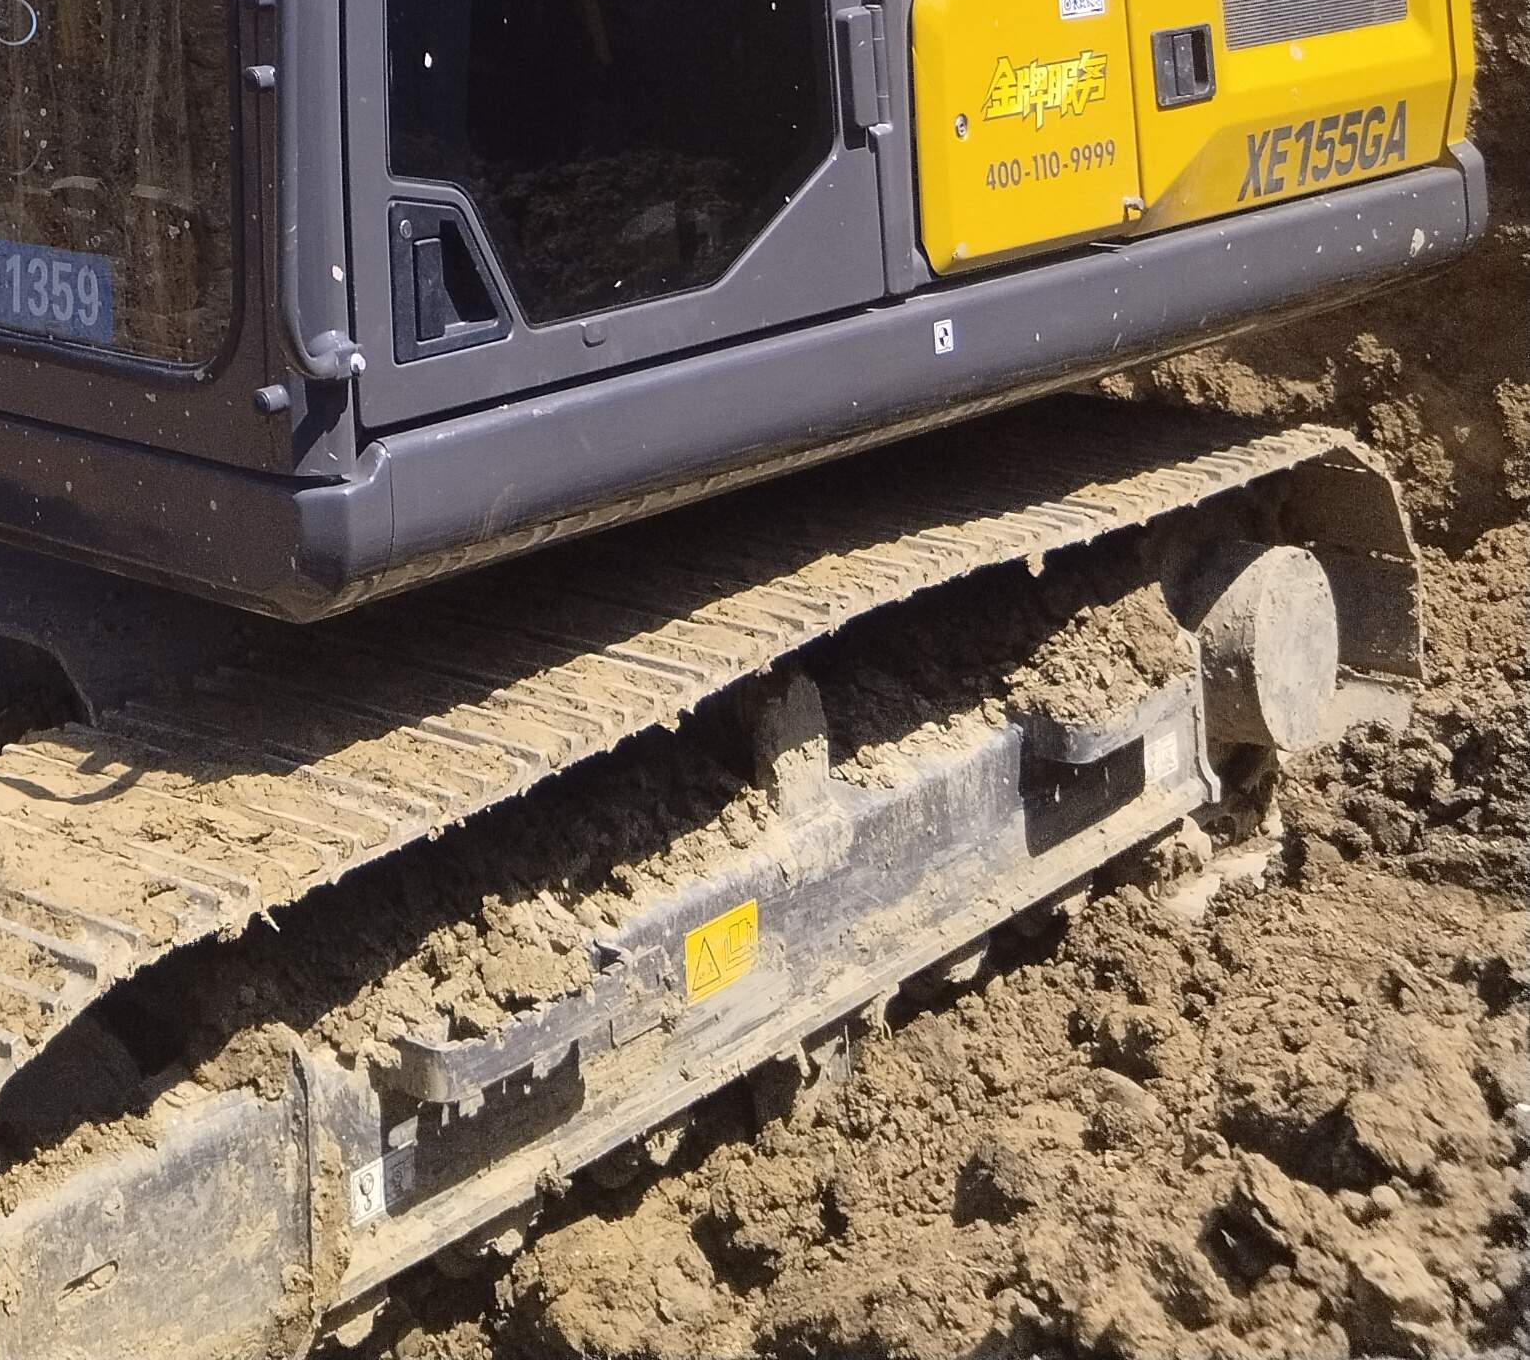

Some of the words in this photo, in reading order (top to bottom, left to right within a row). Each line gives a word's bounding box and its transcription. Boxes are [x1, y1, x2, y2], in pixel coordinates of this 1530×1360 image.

[981, 49, 1108, 132] 金牌服务
[986, 138, 1116, 191] 400-110-9999
[1237, 99, 1408, 202] XE155GA
